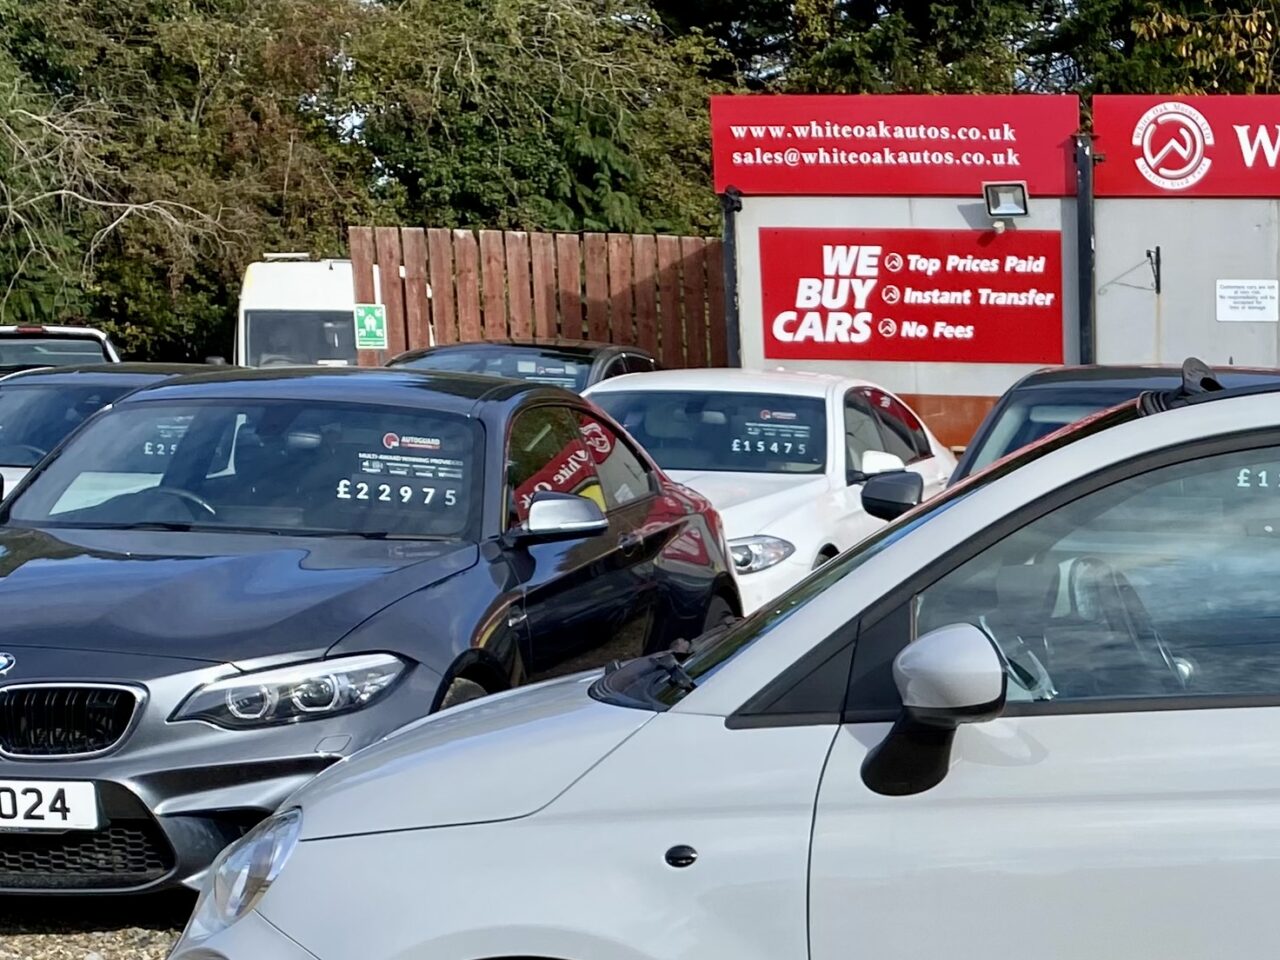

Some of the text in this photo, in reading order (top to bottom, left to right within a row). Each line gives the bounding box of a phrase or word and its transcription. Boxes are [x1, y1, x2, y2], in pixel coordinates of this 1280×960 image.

[730, 120, 1017, 141] www.whiteoakautos.co.uk
[732, 147, 1020, 167] sales@whiteoakautos.co.uk
[822, 245, 882, 277] WE
[907, 254, 1046, 276] Top Prices Paid
[795, 277, 878, 310] BUY
[903, 288, 1055, 306] Instant Transfer
[772, 310, 873, 344] CARS
[900, 320, 974, 339] No Fees
[731, 438, 806, 455] £15475
[336, 478, 457, 506] £22975
